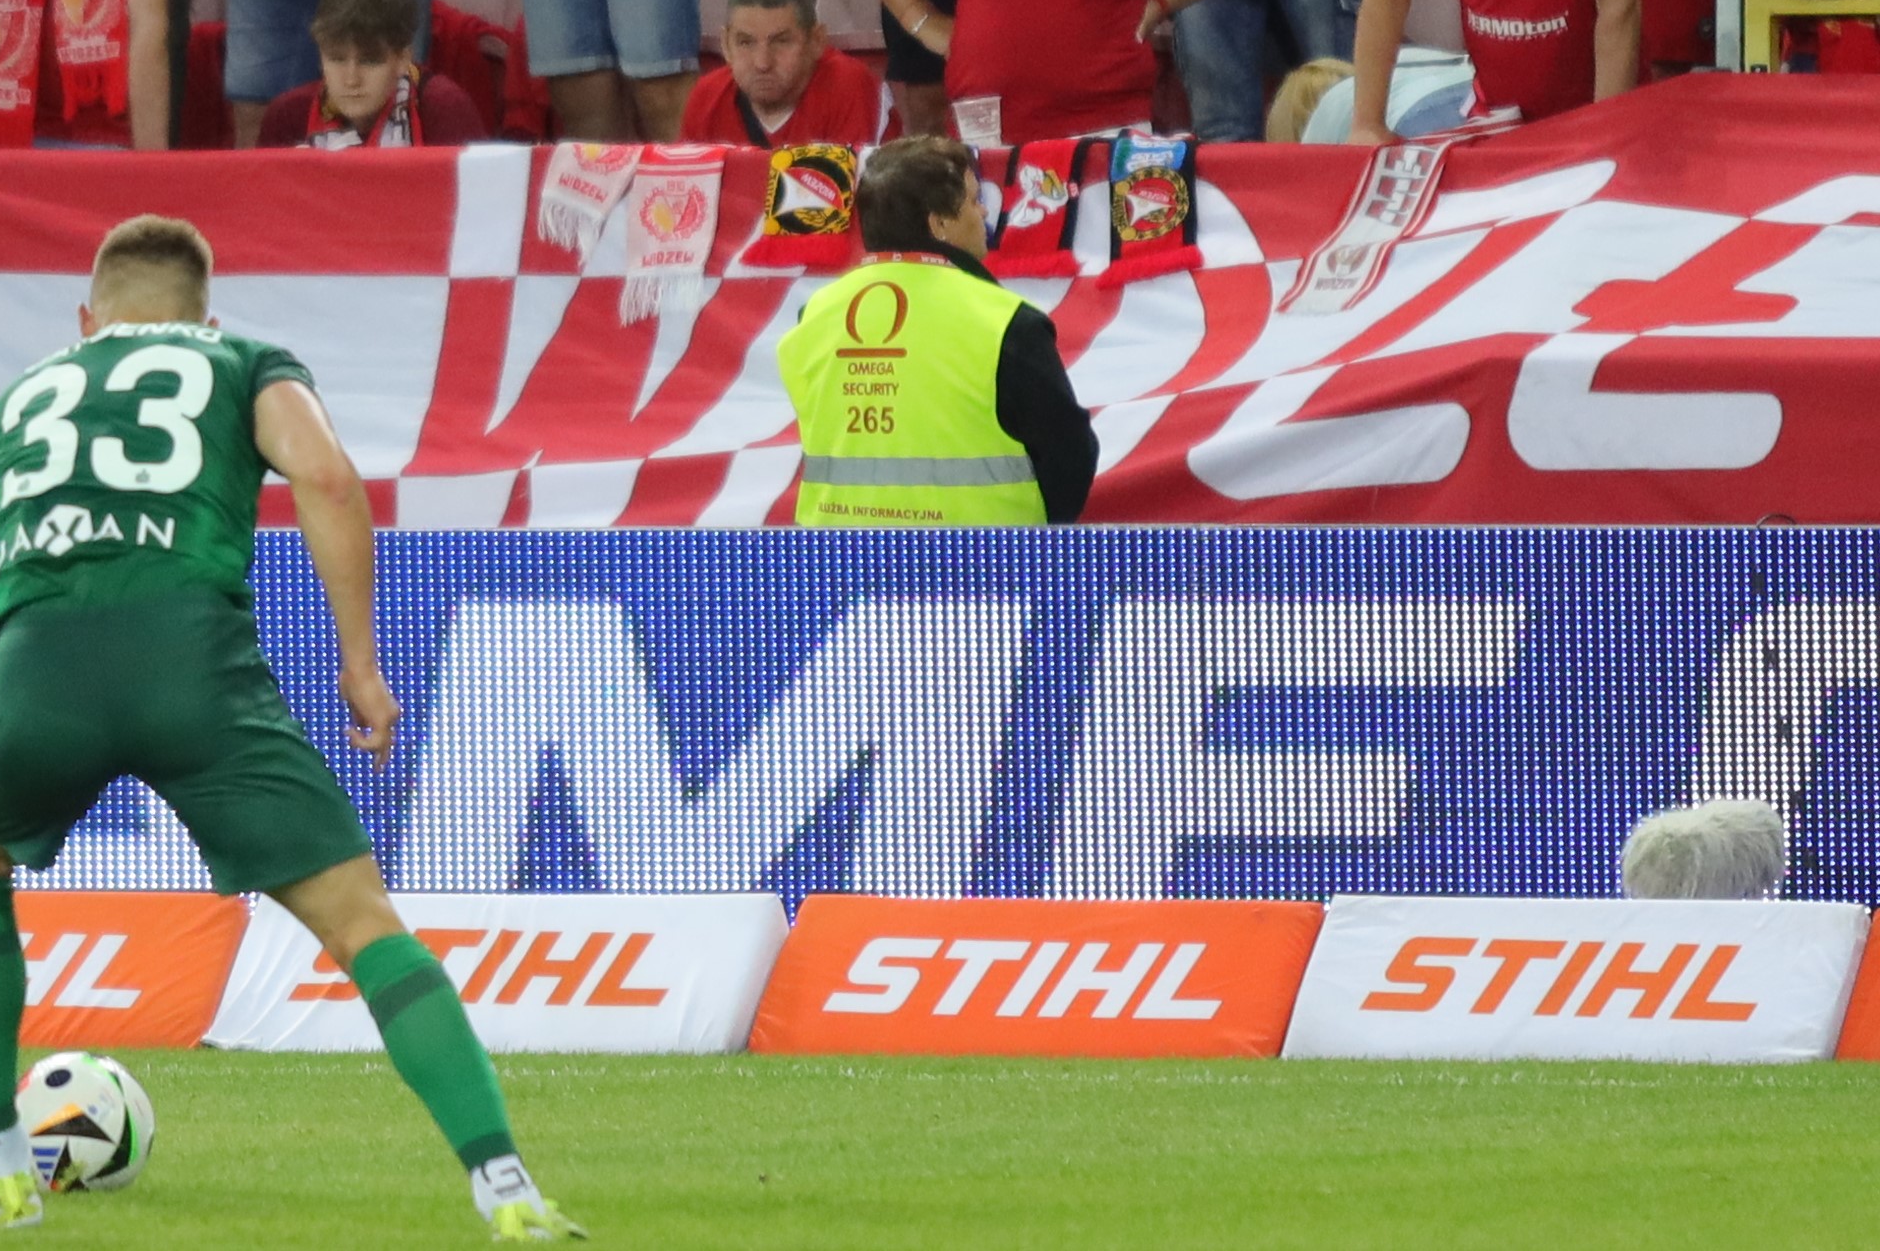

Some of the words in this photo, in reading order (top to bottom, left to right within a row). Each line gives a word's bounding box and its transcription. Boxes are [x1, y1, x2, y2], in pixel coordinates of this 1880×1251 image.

[558, 172, 610, 204] WIDZEW
[641, 251, 696, 267] WIDZEW
[847, 362, 895, 376] OMEGA
[842, 382, 900, 397] SECURITY
[1, 344, 214, 508] 33
[846, 406, 895, 435] 265
[853, 505, 944, 521] INFORMACYJNA
[820, 935, 1223, 1020] STIHL
[1359, 935, 1759, 1022] STIHL
